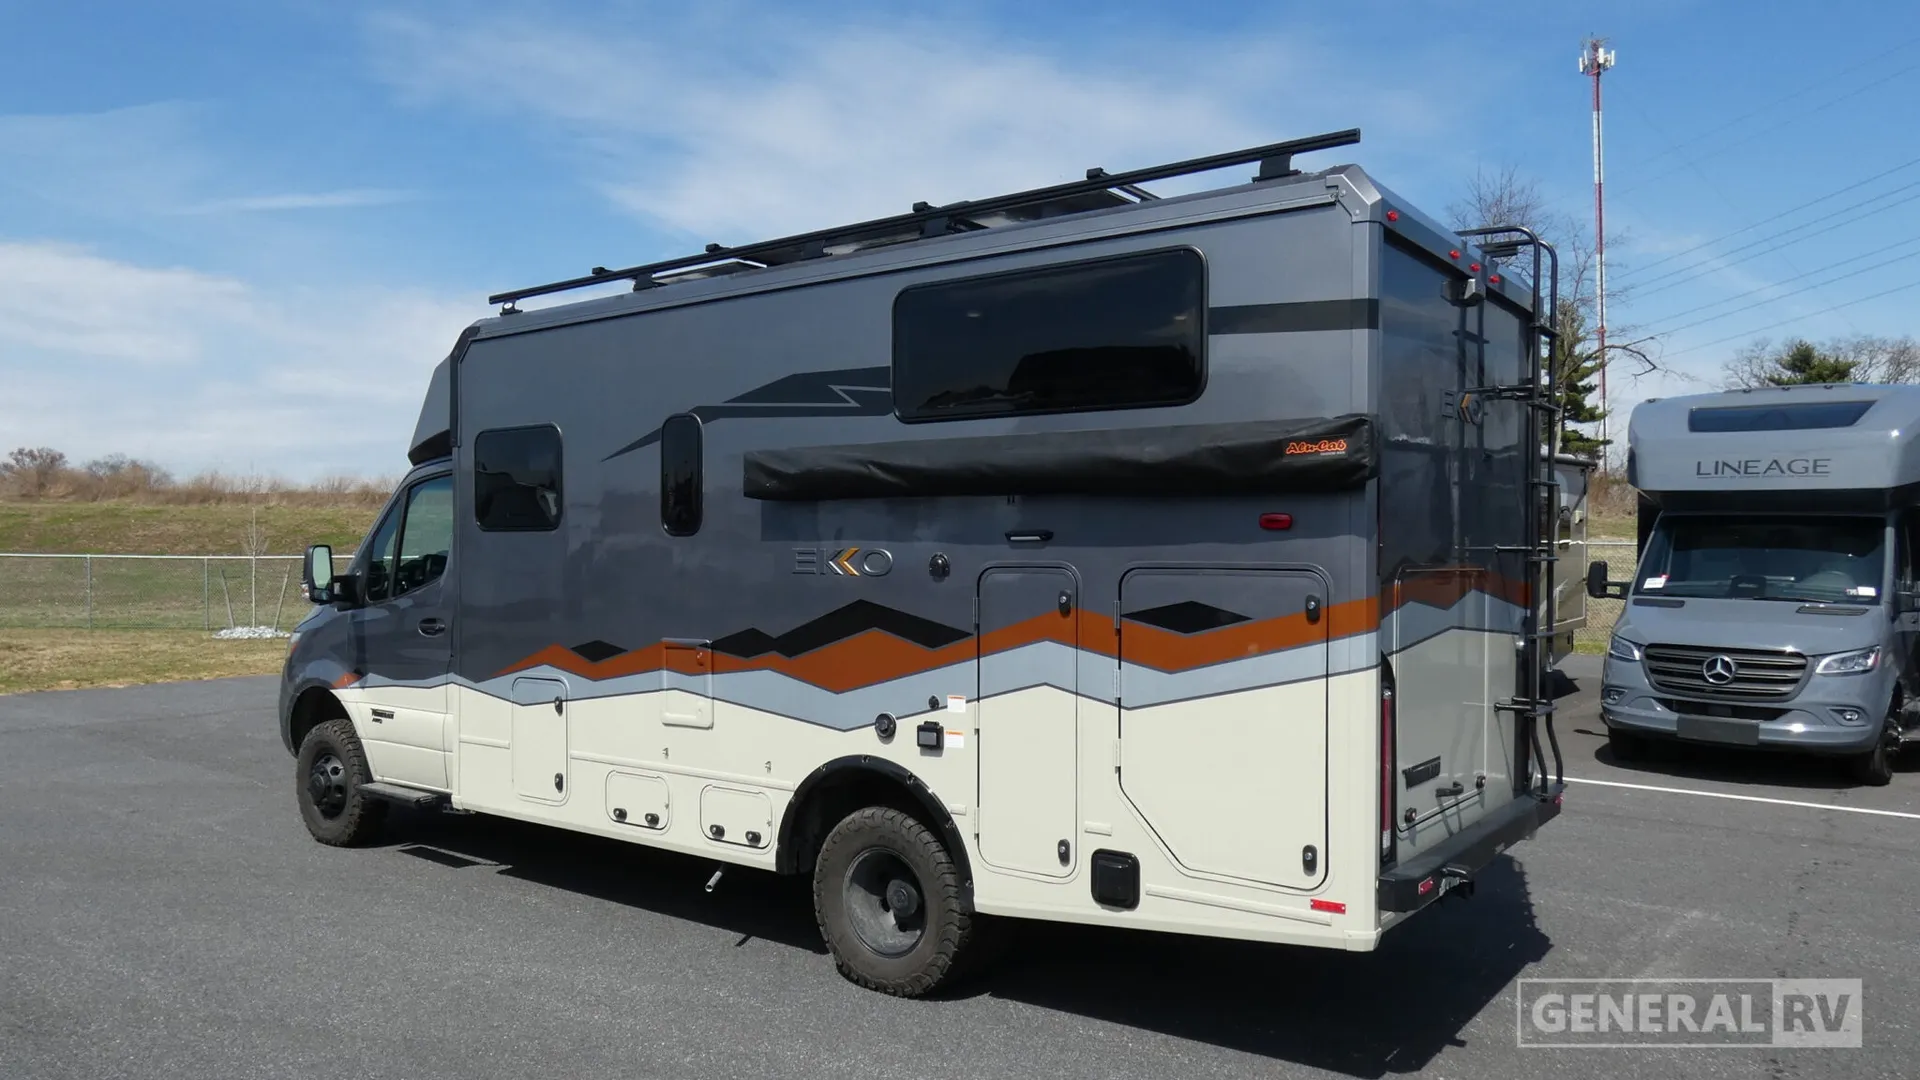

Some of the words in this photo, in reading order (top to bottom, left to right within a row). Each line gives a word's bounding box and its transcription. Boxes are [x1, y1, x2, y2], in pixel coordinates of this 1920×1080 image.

[1286, 439, 1347, 455] Alu-Cab
[1696, 458, 1832, 476] LINEAGE
[791, 547, 893, 577] EKKO
